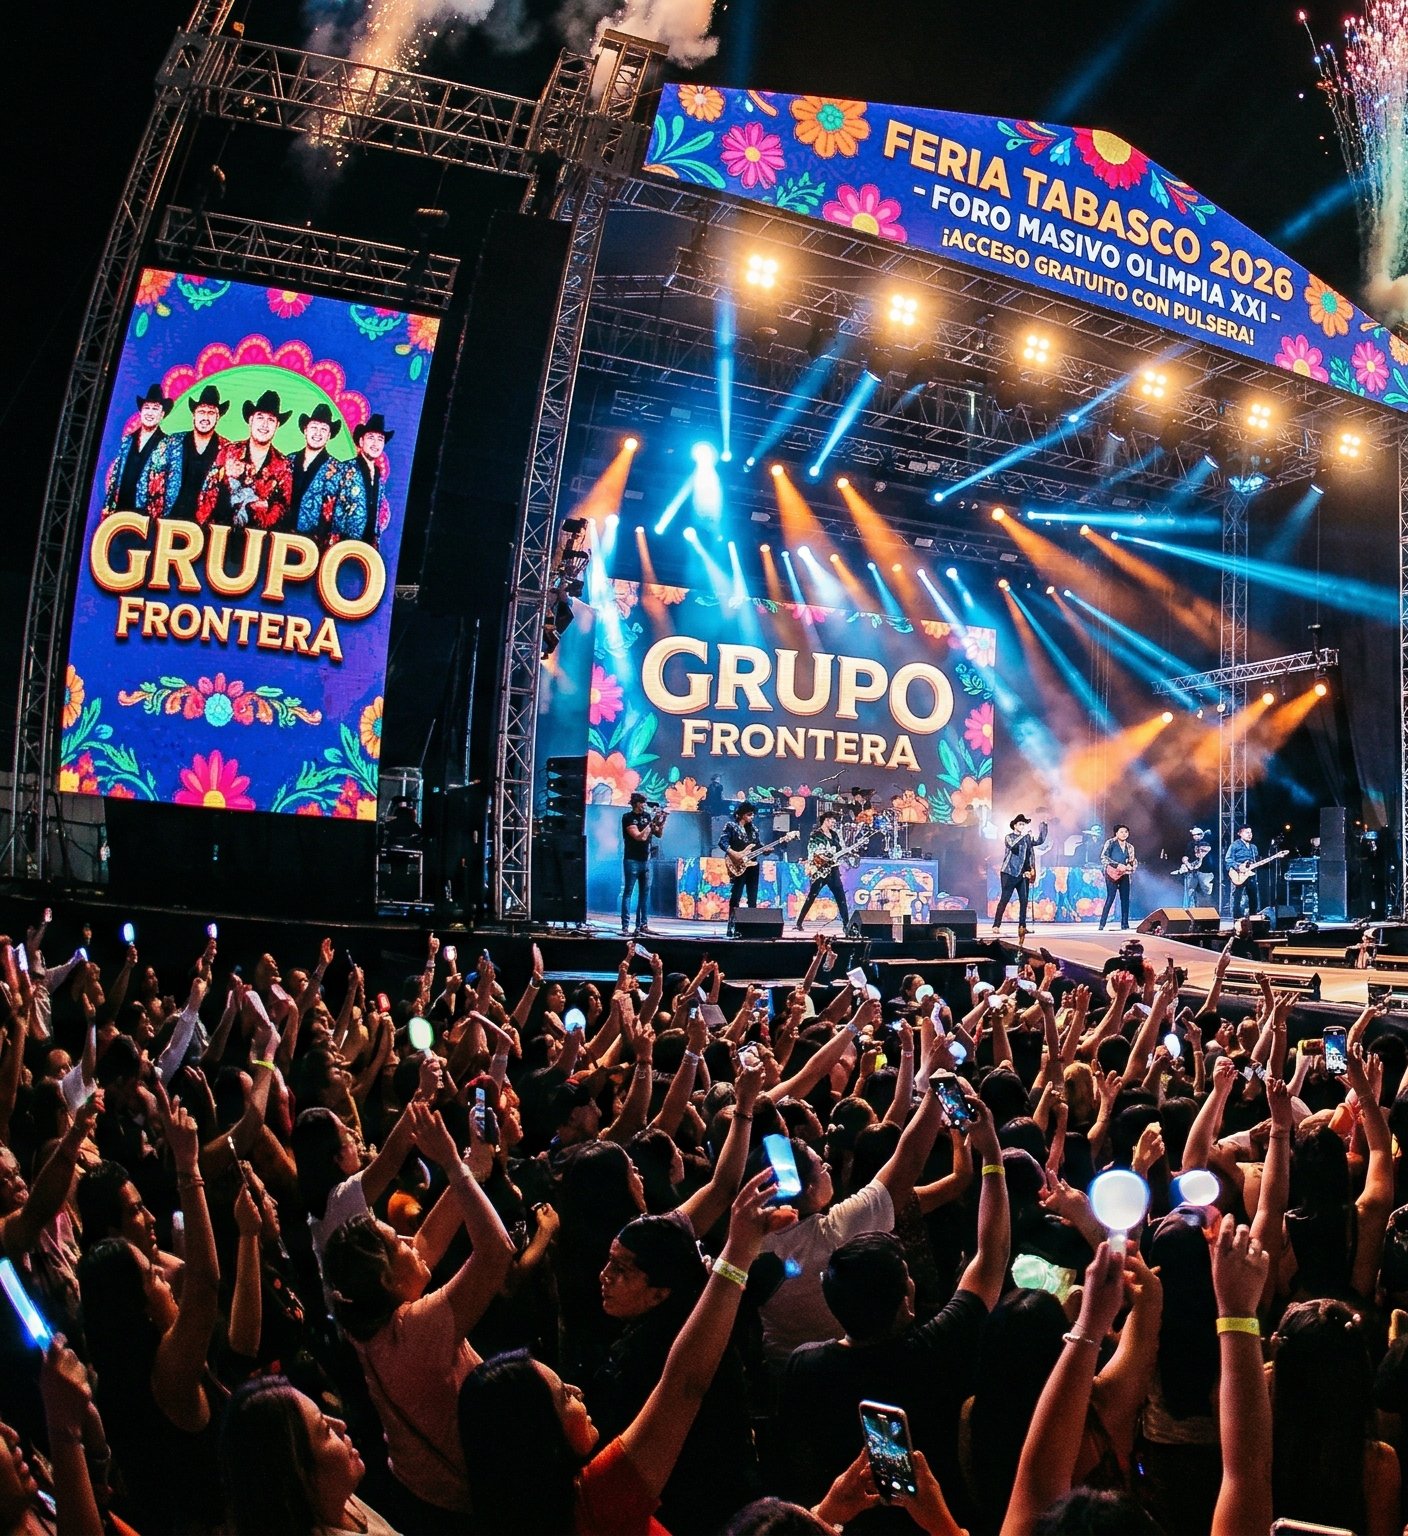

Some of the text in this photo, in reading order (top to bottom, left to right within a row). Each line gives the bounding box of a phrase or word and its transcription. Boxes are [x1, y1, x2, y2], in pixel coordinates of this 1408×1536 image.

[884, 119, 1294, 301] FERIA TABASCO 2026
[931, 184, 1011, 231] FORO
[1017, 213, 1121, 269] MASIVO
[1126, 253, 1225, 308] OLIMPIA
[1230, 289, 1267, 323] XXI
[942, 228, 1255, 345] ¡ACCESO GRATUITO CON PULSERA!
[90, 511, 386, 620] GRUPO
[115, 597, 343, 660] FRONTERA
[641, 636, 954, 734] GRUPO
[682, 720, 922, 771] FRONTERA
